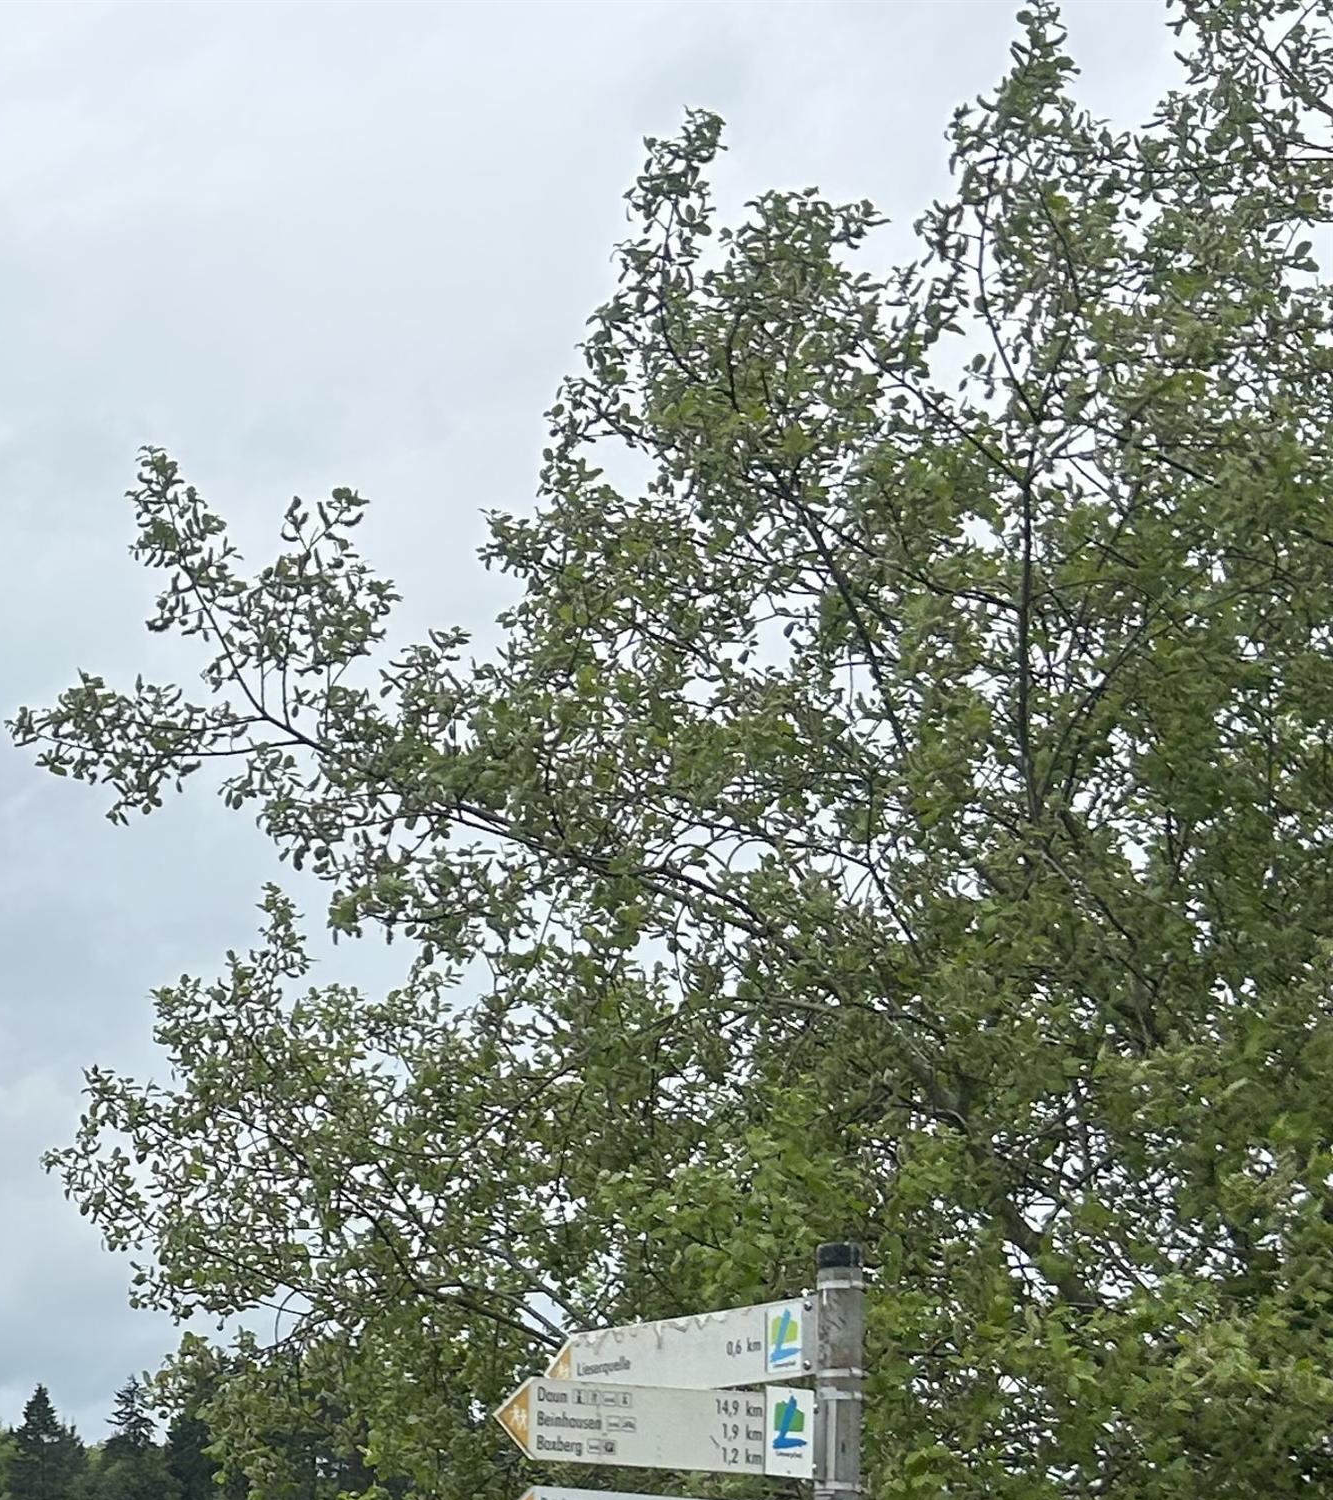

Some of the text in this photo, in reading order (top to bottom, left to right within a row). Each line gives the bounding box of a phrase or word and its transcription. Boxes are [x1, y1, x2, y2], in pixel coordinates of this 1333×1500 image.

[726, 1339, 742, 1357] 0,6
[747, 1338, 761, 1352] km
[537, 1386, 763, 1418] Daun 14,9 km
[536, 1410, 763, 1442] Beinhausen 1,9 km
[536, 1434, 583, 1457] Boxberg
[721, 1447, 739, 1466] 1,2
[745, 1448, 762, 1464] km
